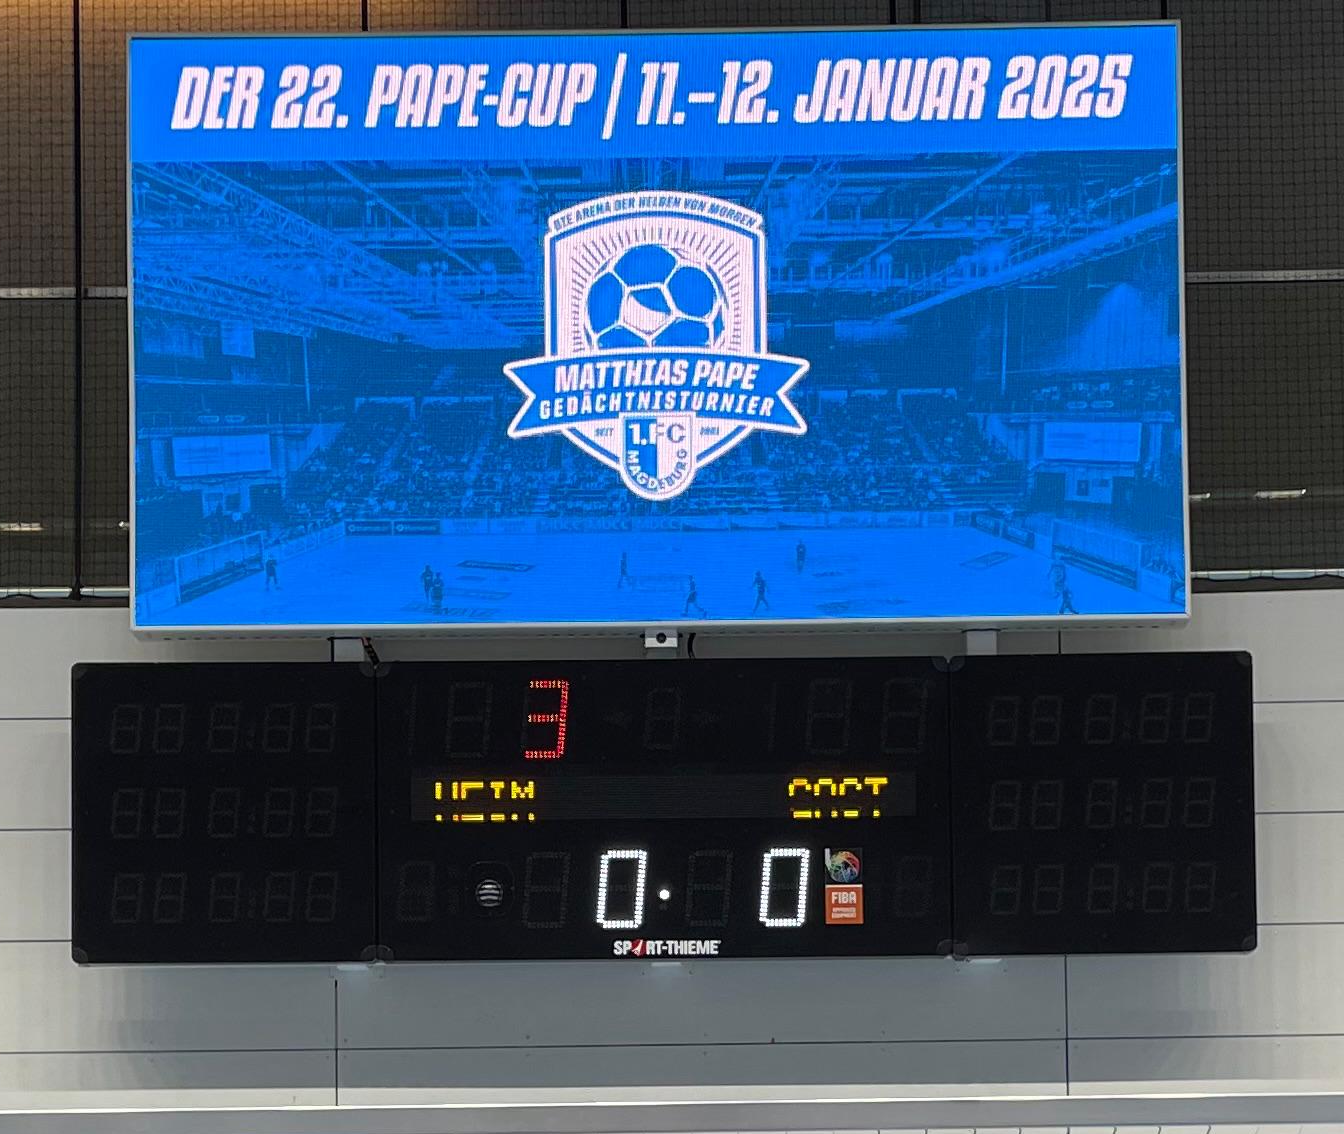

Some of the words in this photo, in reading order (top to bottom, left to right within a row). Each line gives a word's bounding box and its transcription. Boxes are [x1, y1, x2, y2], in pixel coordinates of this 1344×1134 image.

[171, 66, 264, 130] DER
[271, 64, 349, 129] 22.
[364, 63, 598, 128] PAPE-CUP
[636, 60, 780, 126] 11.-12.
[794, 56, 992, 124] JANUAR
[997, 53, 1134, 120] 2025
[539, 387, 775, 420] GEDÄCHTNISTURNIER
[555, 359, 689, 393] MATTHIAS
[692, 359, 761, 390] PAPE
[627, 448, 688, 490] MAGDEBURG
[524, 680, 570, 760] 3
[596, 848, 648, 930] 0
[758, 847, 810, 928] 0
[831, 891, 857, 905] FIBA
